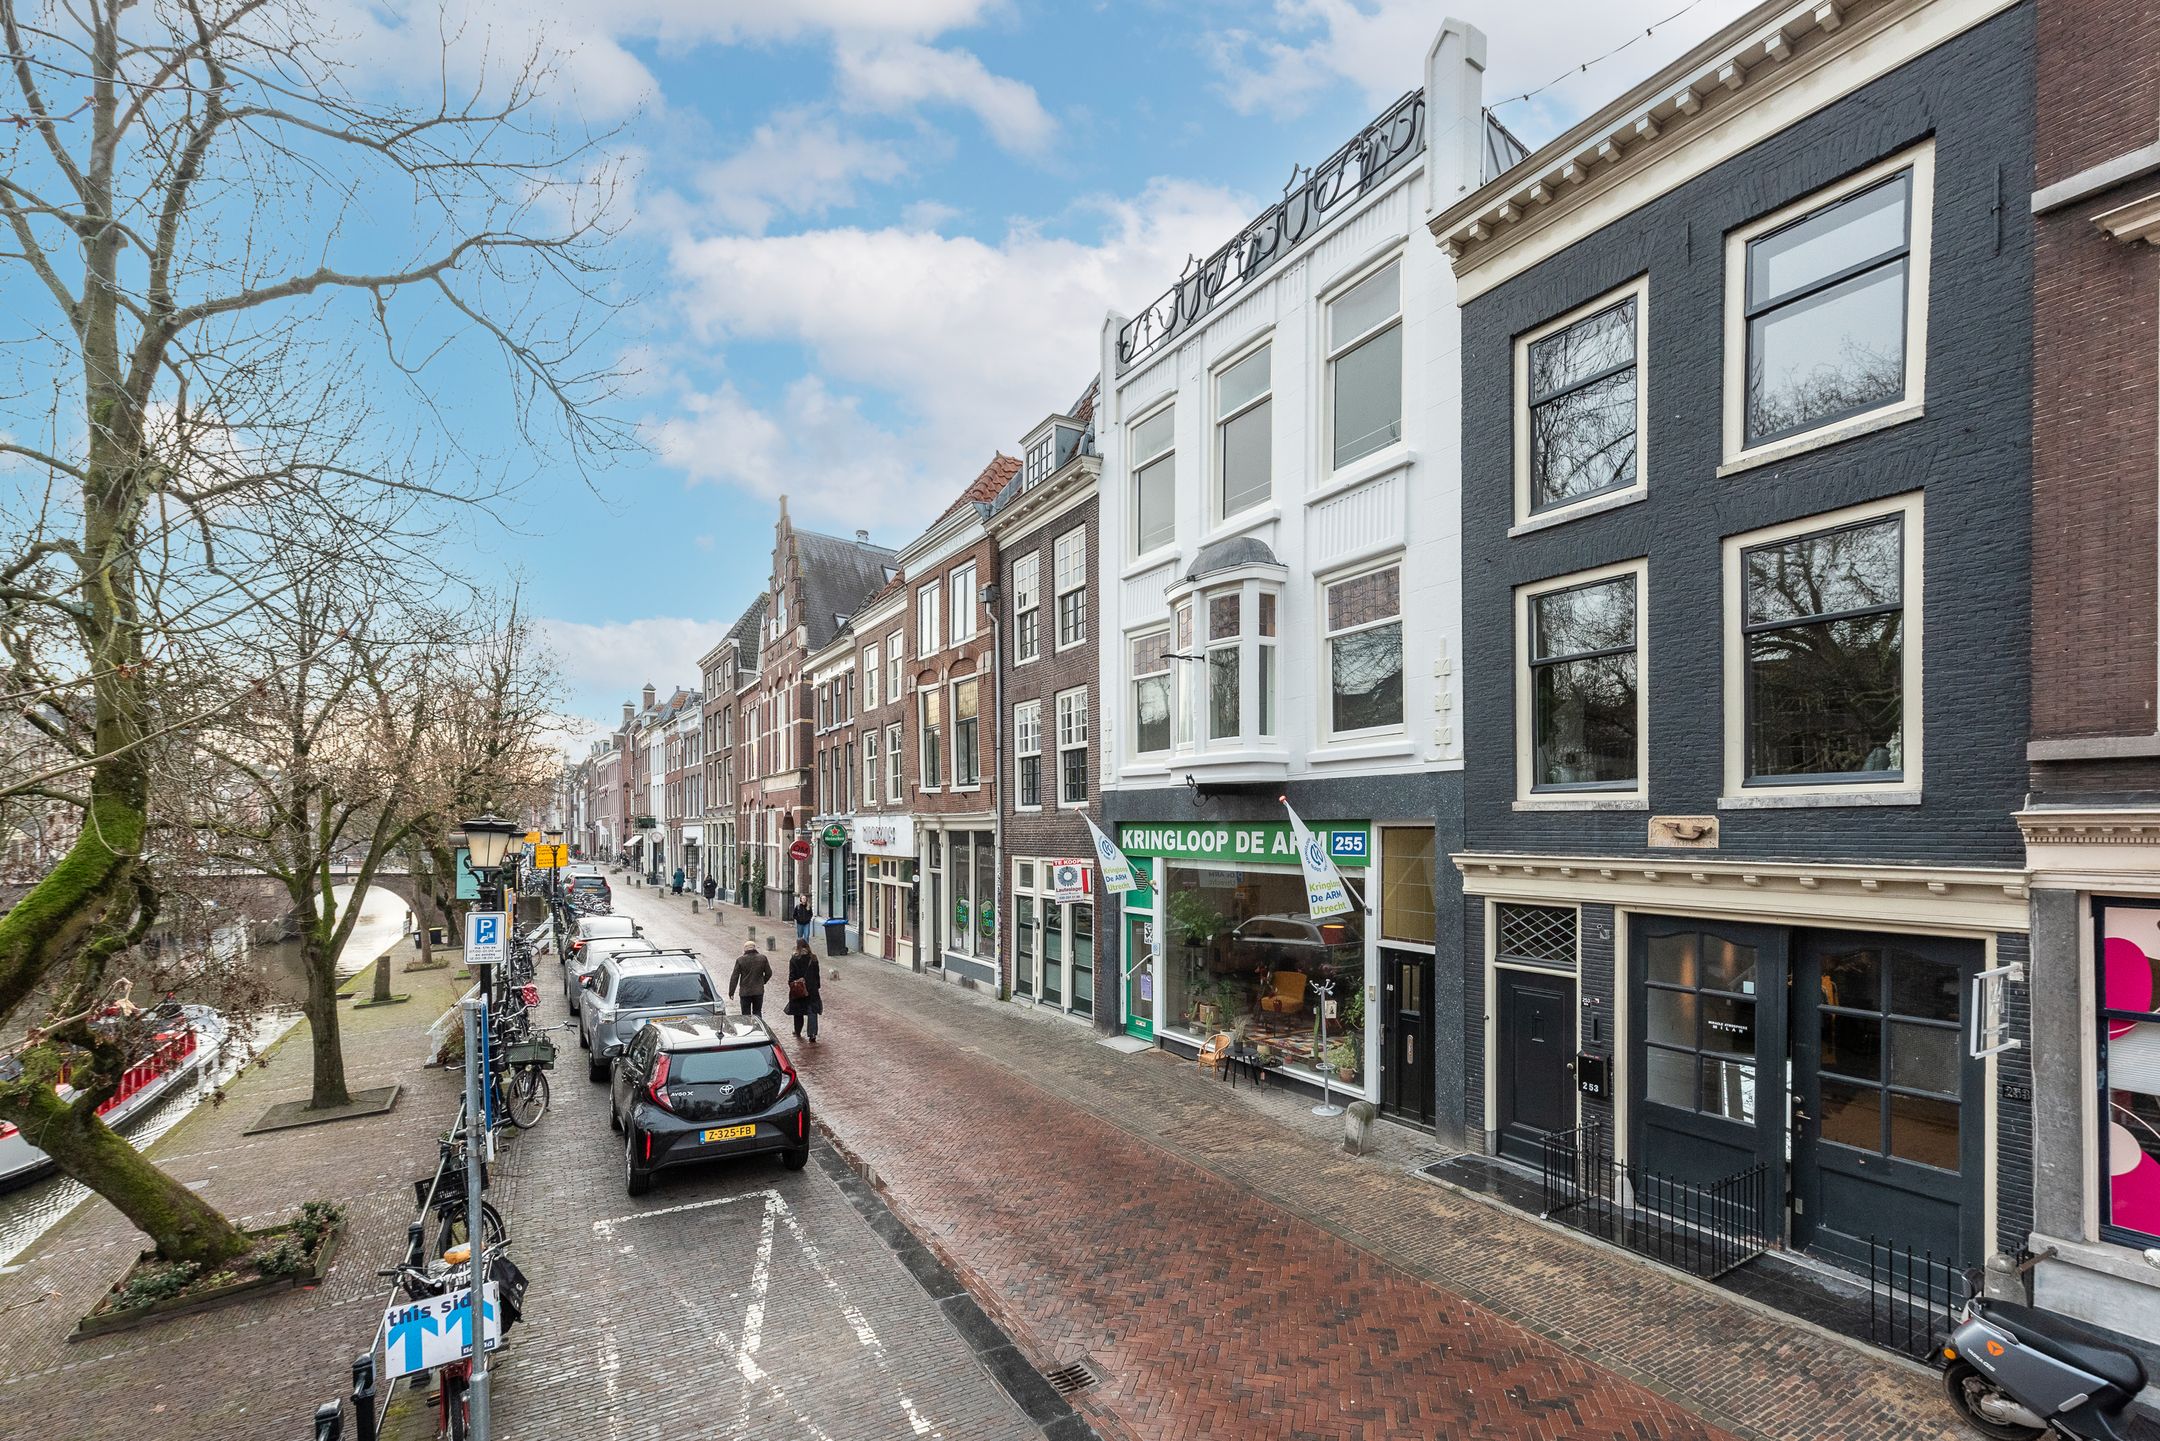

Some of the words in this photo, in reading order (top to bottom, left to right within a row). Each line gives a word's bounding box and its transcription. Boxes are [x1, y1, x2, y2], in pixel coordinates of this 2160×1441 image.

[1122, 829, 1229, 852] KRINGLOOP
[1235, 831, 1265, 854] DE
[1334, 836, 1363, 851] 255
[1115, 873, 1127, 881] ARM
[1310, 894, 1323, 904] De
[1325, 889, 1342, 901] ARM
[1312, 902, 1347, 915] Utrecht
[480, 919, 493, 934] P
[1582, 1081, 1599, 1093] 253
[708, 1126, 752, 1140] Z-325-FB
[387, 1304, 432, 1327] this
[441, 1291, 473, 1314] sid
